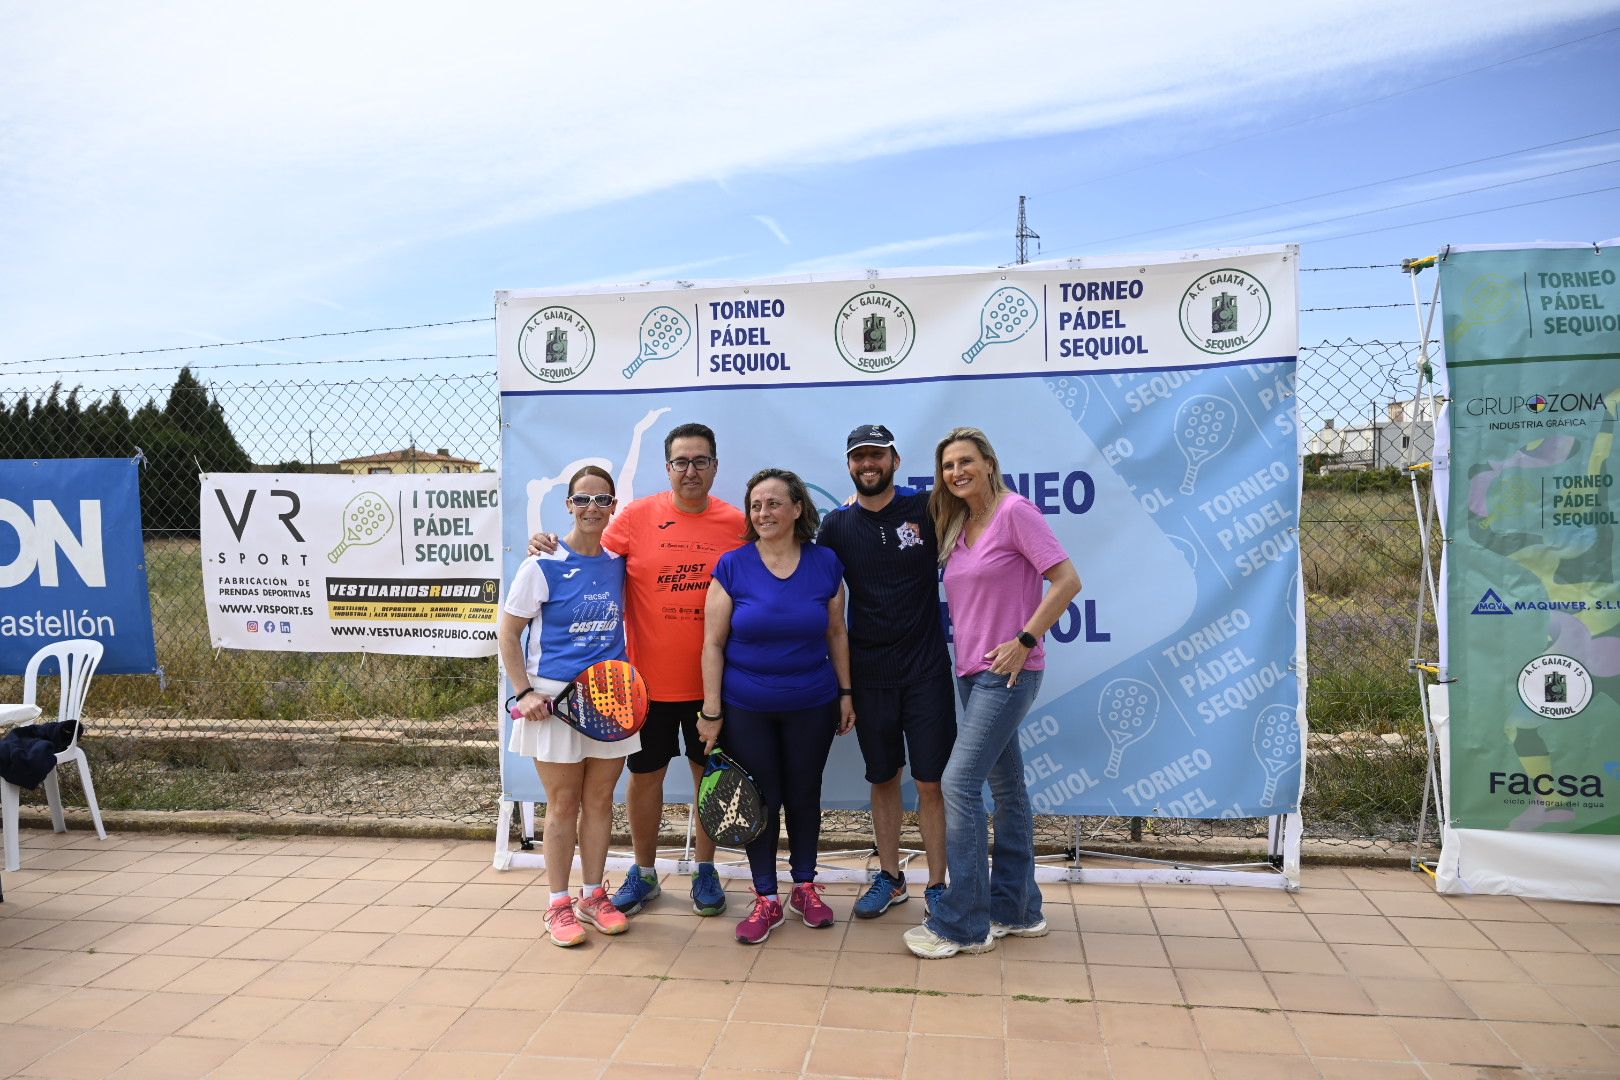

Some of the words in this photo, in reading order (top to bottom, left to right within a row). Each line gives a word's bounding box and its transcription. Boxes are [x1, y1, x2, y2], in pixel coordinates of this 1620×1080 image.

[1188, 283, 1207, 300] A.C.
[1209, 273, 1245, 286] GAIATA
[1246, 284, 1259, 296] 15
[1537, 269, 1616, 288] TORNEO
[1059, 279, 1143, 302] TORNEO
[709, 299, 785, 321] TORNEO
[842, 304, 858, 319] A.C.
[860, 296, 891, 308] GAIATA
[893, 306, 904, 318] 15
[1541, 292, 1604, 311] PÁDEL
[527, 318, 542, 332] A.C.
[544, 311, 573, 323] GAIATA
[575, 321, 585, 332] 15
[1059, 307, 1126, 331] PÁDEL
[710, 326, 770, 348] PÁDEL
[1204, 335, 1248, 351] SEQUIOL
[1059, 335, 1149, 360] SEQUIOL
[710, 352, 791, 375] SEQUIOL
[857, 356, 895, 369] SEQUIOL
[539, 367, 575, 379] SEQUIOL
[1489, 419, 1543, 430] INDUSTRIA
[1553, 474, 1613, 489] TORNEO
[413, 490, 418, 508] I
[425, 489, 498, 508] TORNEO
[1198, 461, 1290, 523] TORNEO
[1553, 492, 1602, 508] PÁDEL
[214, 489, 306, 543] VR
[413, 513, 473, 536] PÁDEL
[1553, 512, 1619, 527] SEQUIOL
[1217, 500, 1294, 552] PÁDEL
[218, 552, 307, 566] SPORT
[415, 543, 494, 566] SEQUIOL
[676, 563, 706, 573] JUST
[219, 577, 287, 586] FABRICACIÓN
[298, 579, 310, 587] DE
[657, 573, 687, 583] KEEP
[219, 588, 259, 596] PRENDAS
[262, 589, 311, 598] DEPORTIVAS
[219, 604, 313, 616] WWW.VRSPORT.ES
[1478, 602, 1503, 611] MQV
[1514, 601, 1591, 611] MAQUIVER,
[331, 626, 498, 641] WWW.VESTUARIOSRUBIO.COM
[1162, 608, 1251, 668] TORNEO
[1179, 647, 1256, 698] PÁDEL
[1524, 664, 1541, 676] A.C.
[1542, 658, 1572, 669] GAIATA
[1573, 666, 1585, 677] 15
[1197, 661, 1288, 724] SEQUIOL
[1539, 706, 1576, 716] SEQUIOL
[1121, 748, 1212, 807] TORNEO
[1490, 772, 1604, 798] Facsa
